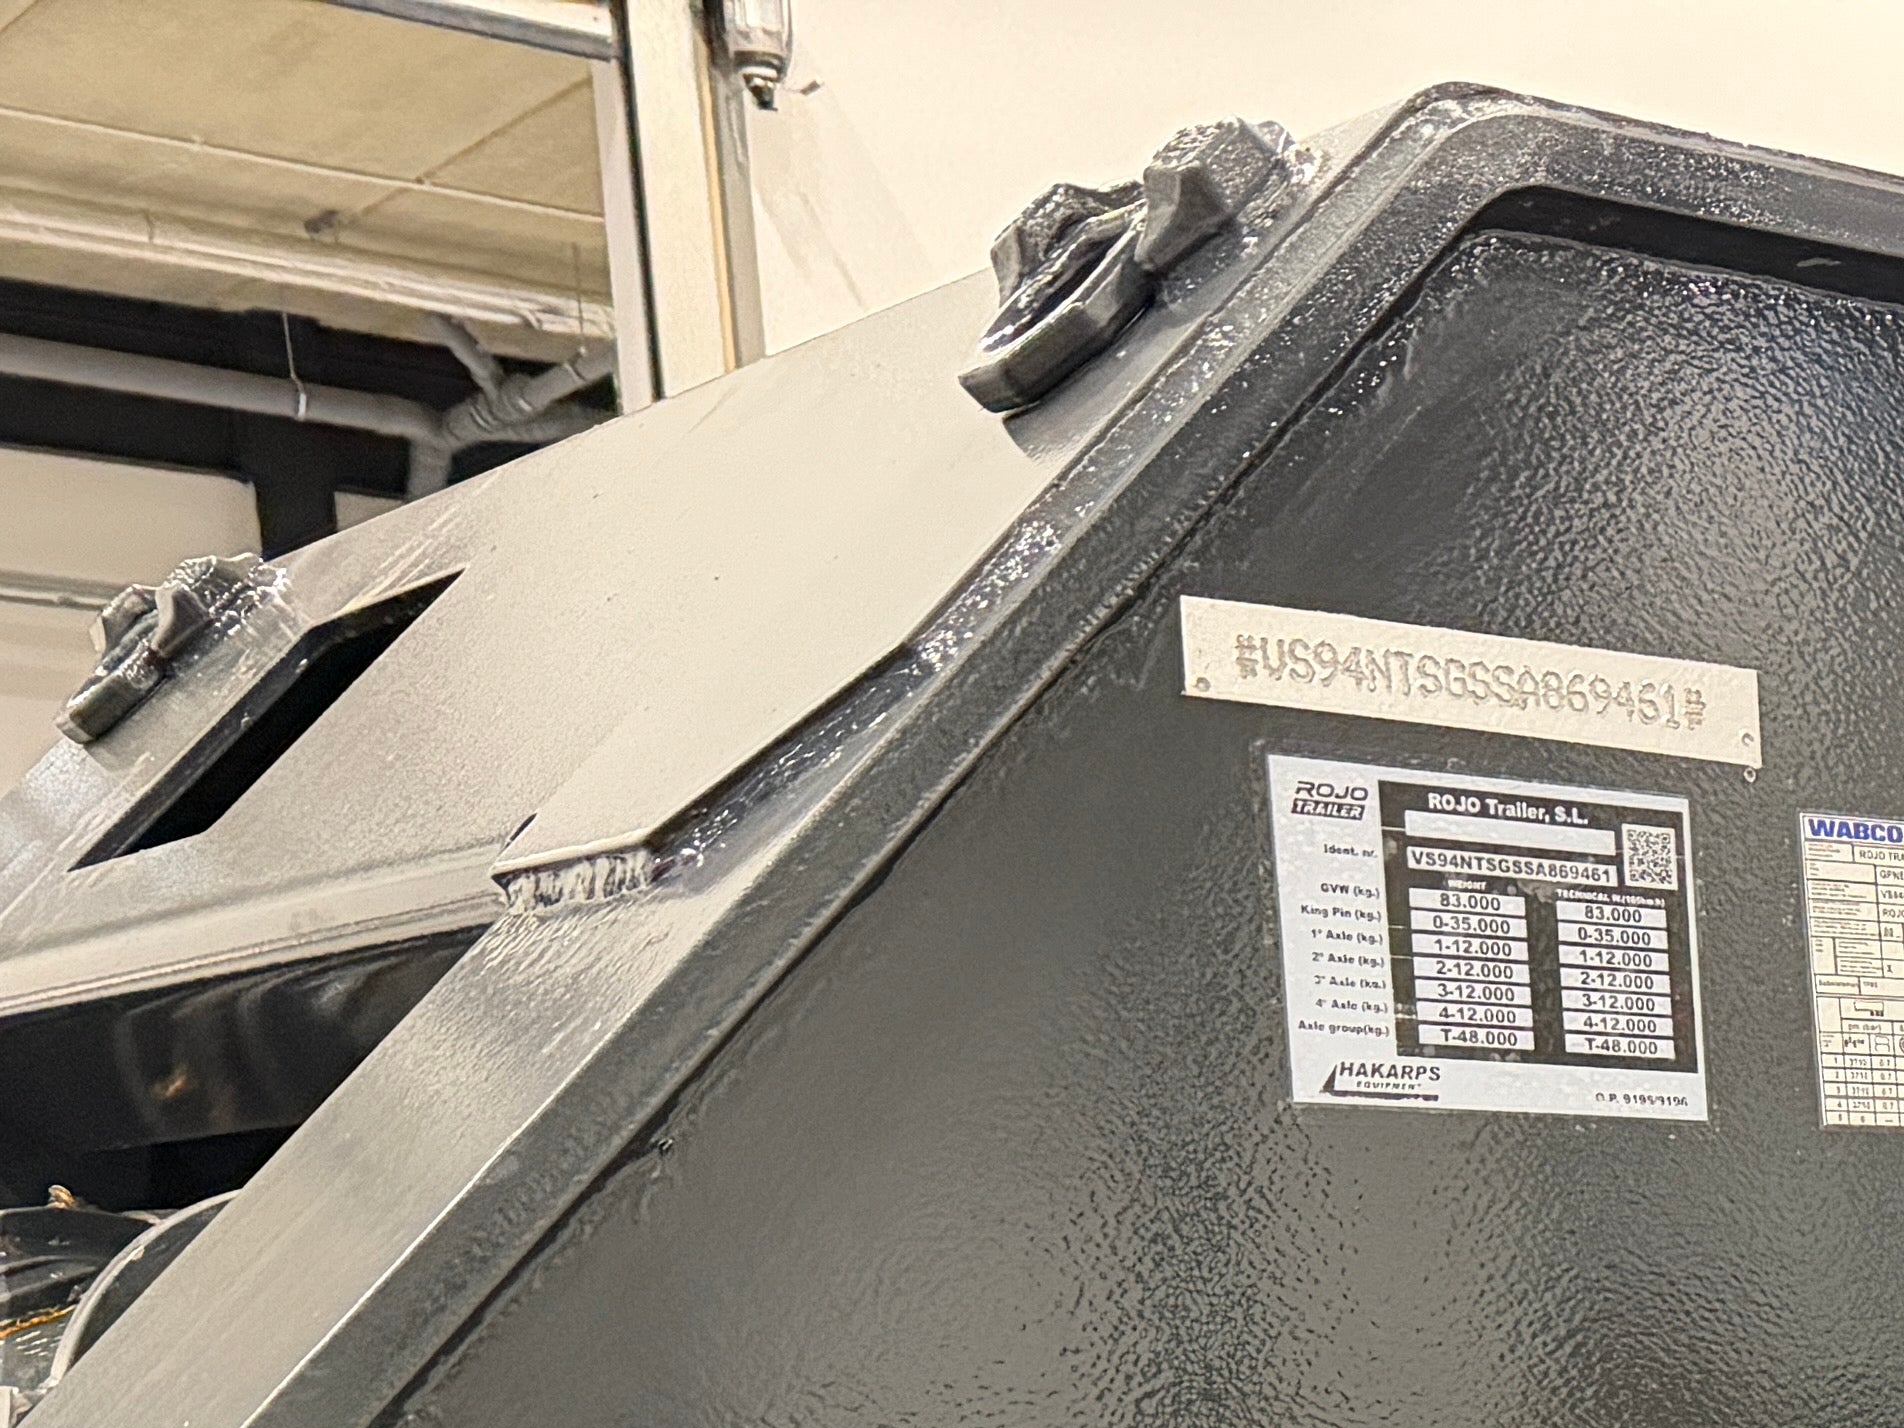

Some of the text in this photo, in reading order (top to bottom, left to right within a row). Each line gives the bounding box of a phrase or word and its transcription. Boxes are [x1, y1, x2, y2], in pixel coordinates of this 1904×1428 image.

[1295, 780, 1369, 801] ROJO
[1294, 800, 1363, 819] TRAILER
[1428, 792, 1588, 824] ROJO Trailer, S.L.
[1808, 818, 1904, 844] WABCO
[1411, 850, 1610, 882] VS94NTSGSSA869461
[1440, 893, 1501, 912] 83.000
[1584, 905, 1642, 923] 83.000
[1433, 915, 1511, 934] 0-35.000
[1577, 927, 1652, 946] 0-35.000
[1435, 939, 1512, 957] 1-12.000
[1579, 950, 1653, 968] 1-12.000
[1436, 961, 1513, 979] 2-12.000
[1580, 972, 1654, 990] 2-12.000
[1437, 983, 1515, 1002] 3-12.000
[1582, 994, 1656, 1012] 3-12.000
[1439, 1006, 1517, 1024] 4-12.000
[1583, 1016, 1657, 1033] 4-12.000
[1441, 1029, 1518, 1047] T-48.000
[1584, 1038, 1659, 1055] T-48.000
[1339, 1061, 1441, 1082] HAKARPS
